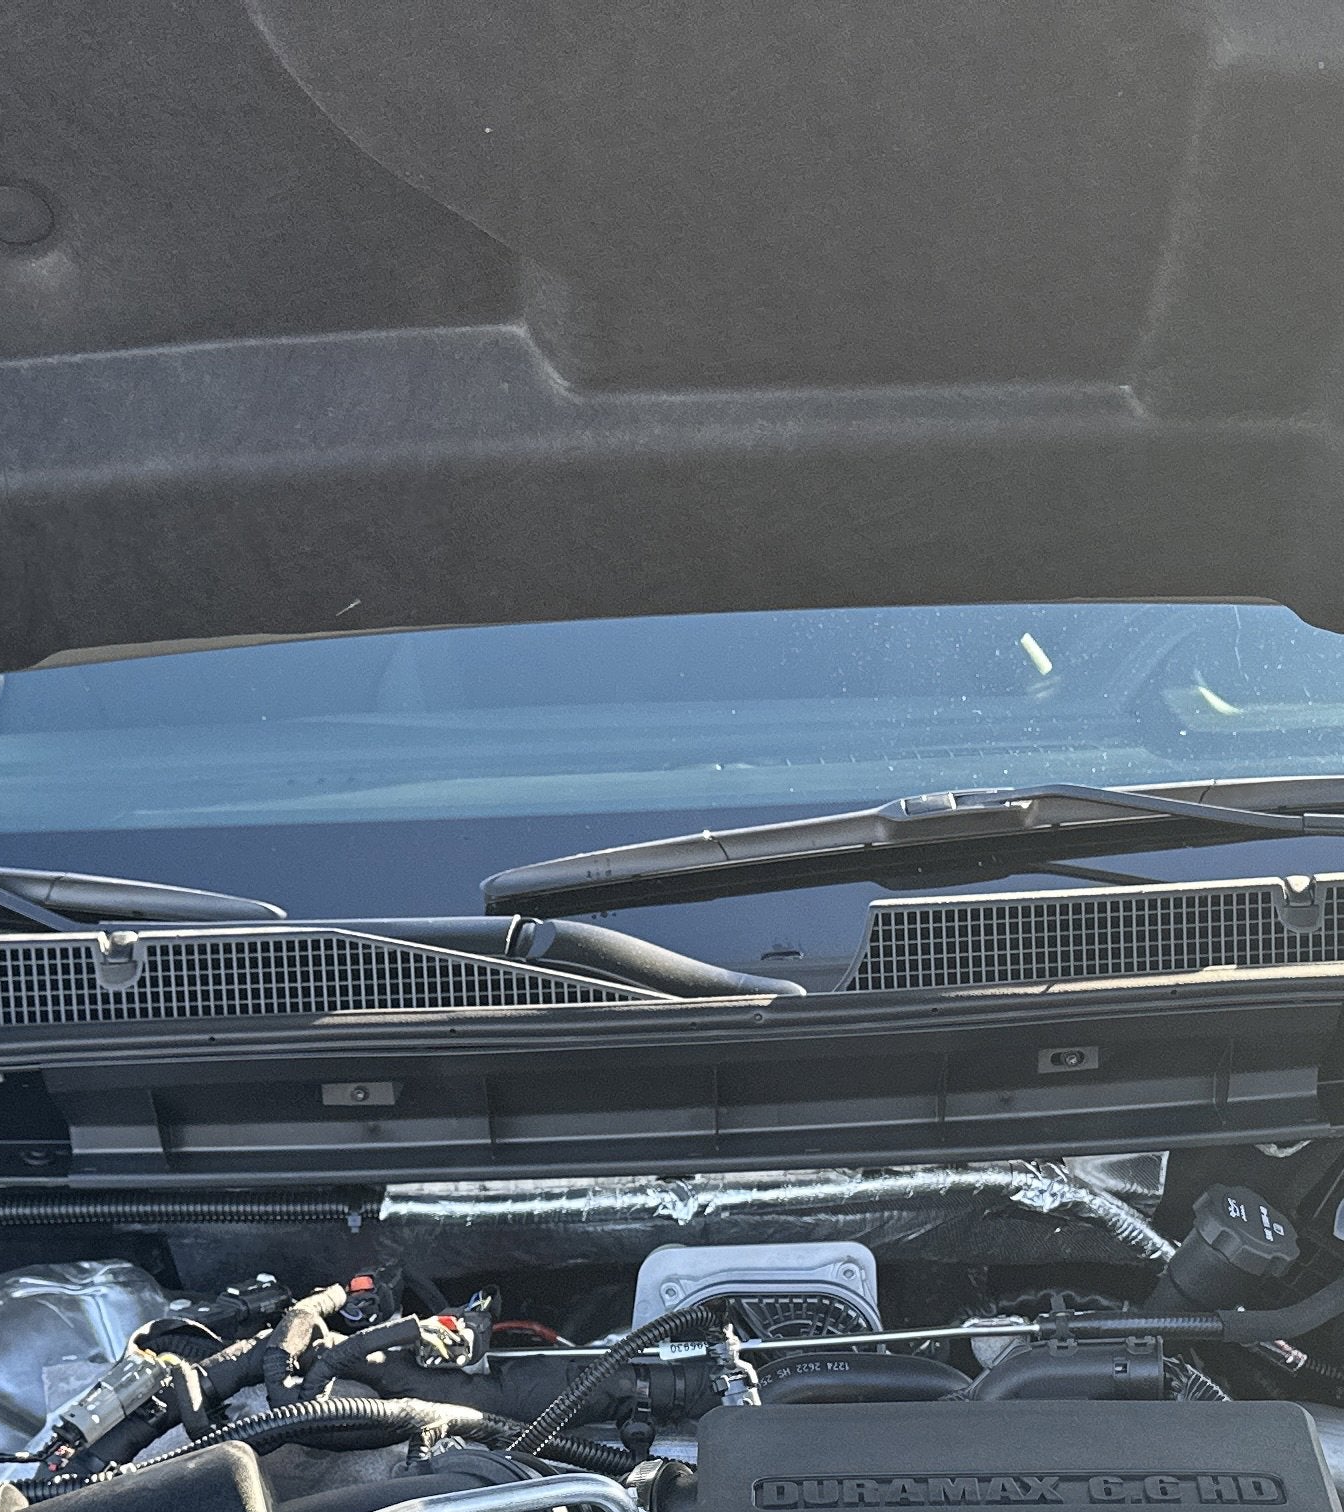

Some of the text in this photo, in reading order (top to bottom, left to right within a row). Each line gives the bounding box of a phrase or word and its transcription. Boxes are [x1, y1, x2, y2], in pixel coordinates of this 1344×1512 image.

[761, 1475, 1280, 1508] DURAMAX 6.6 HD
